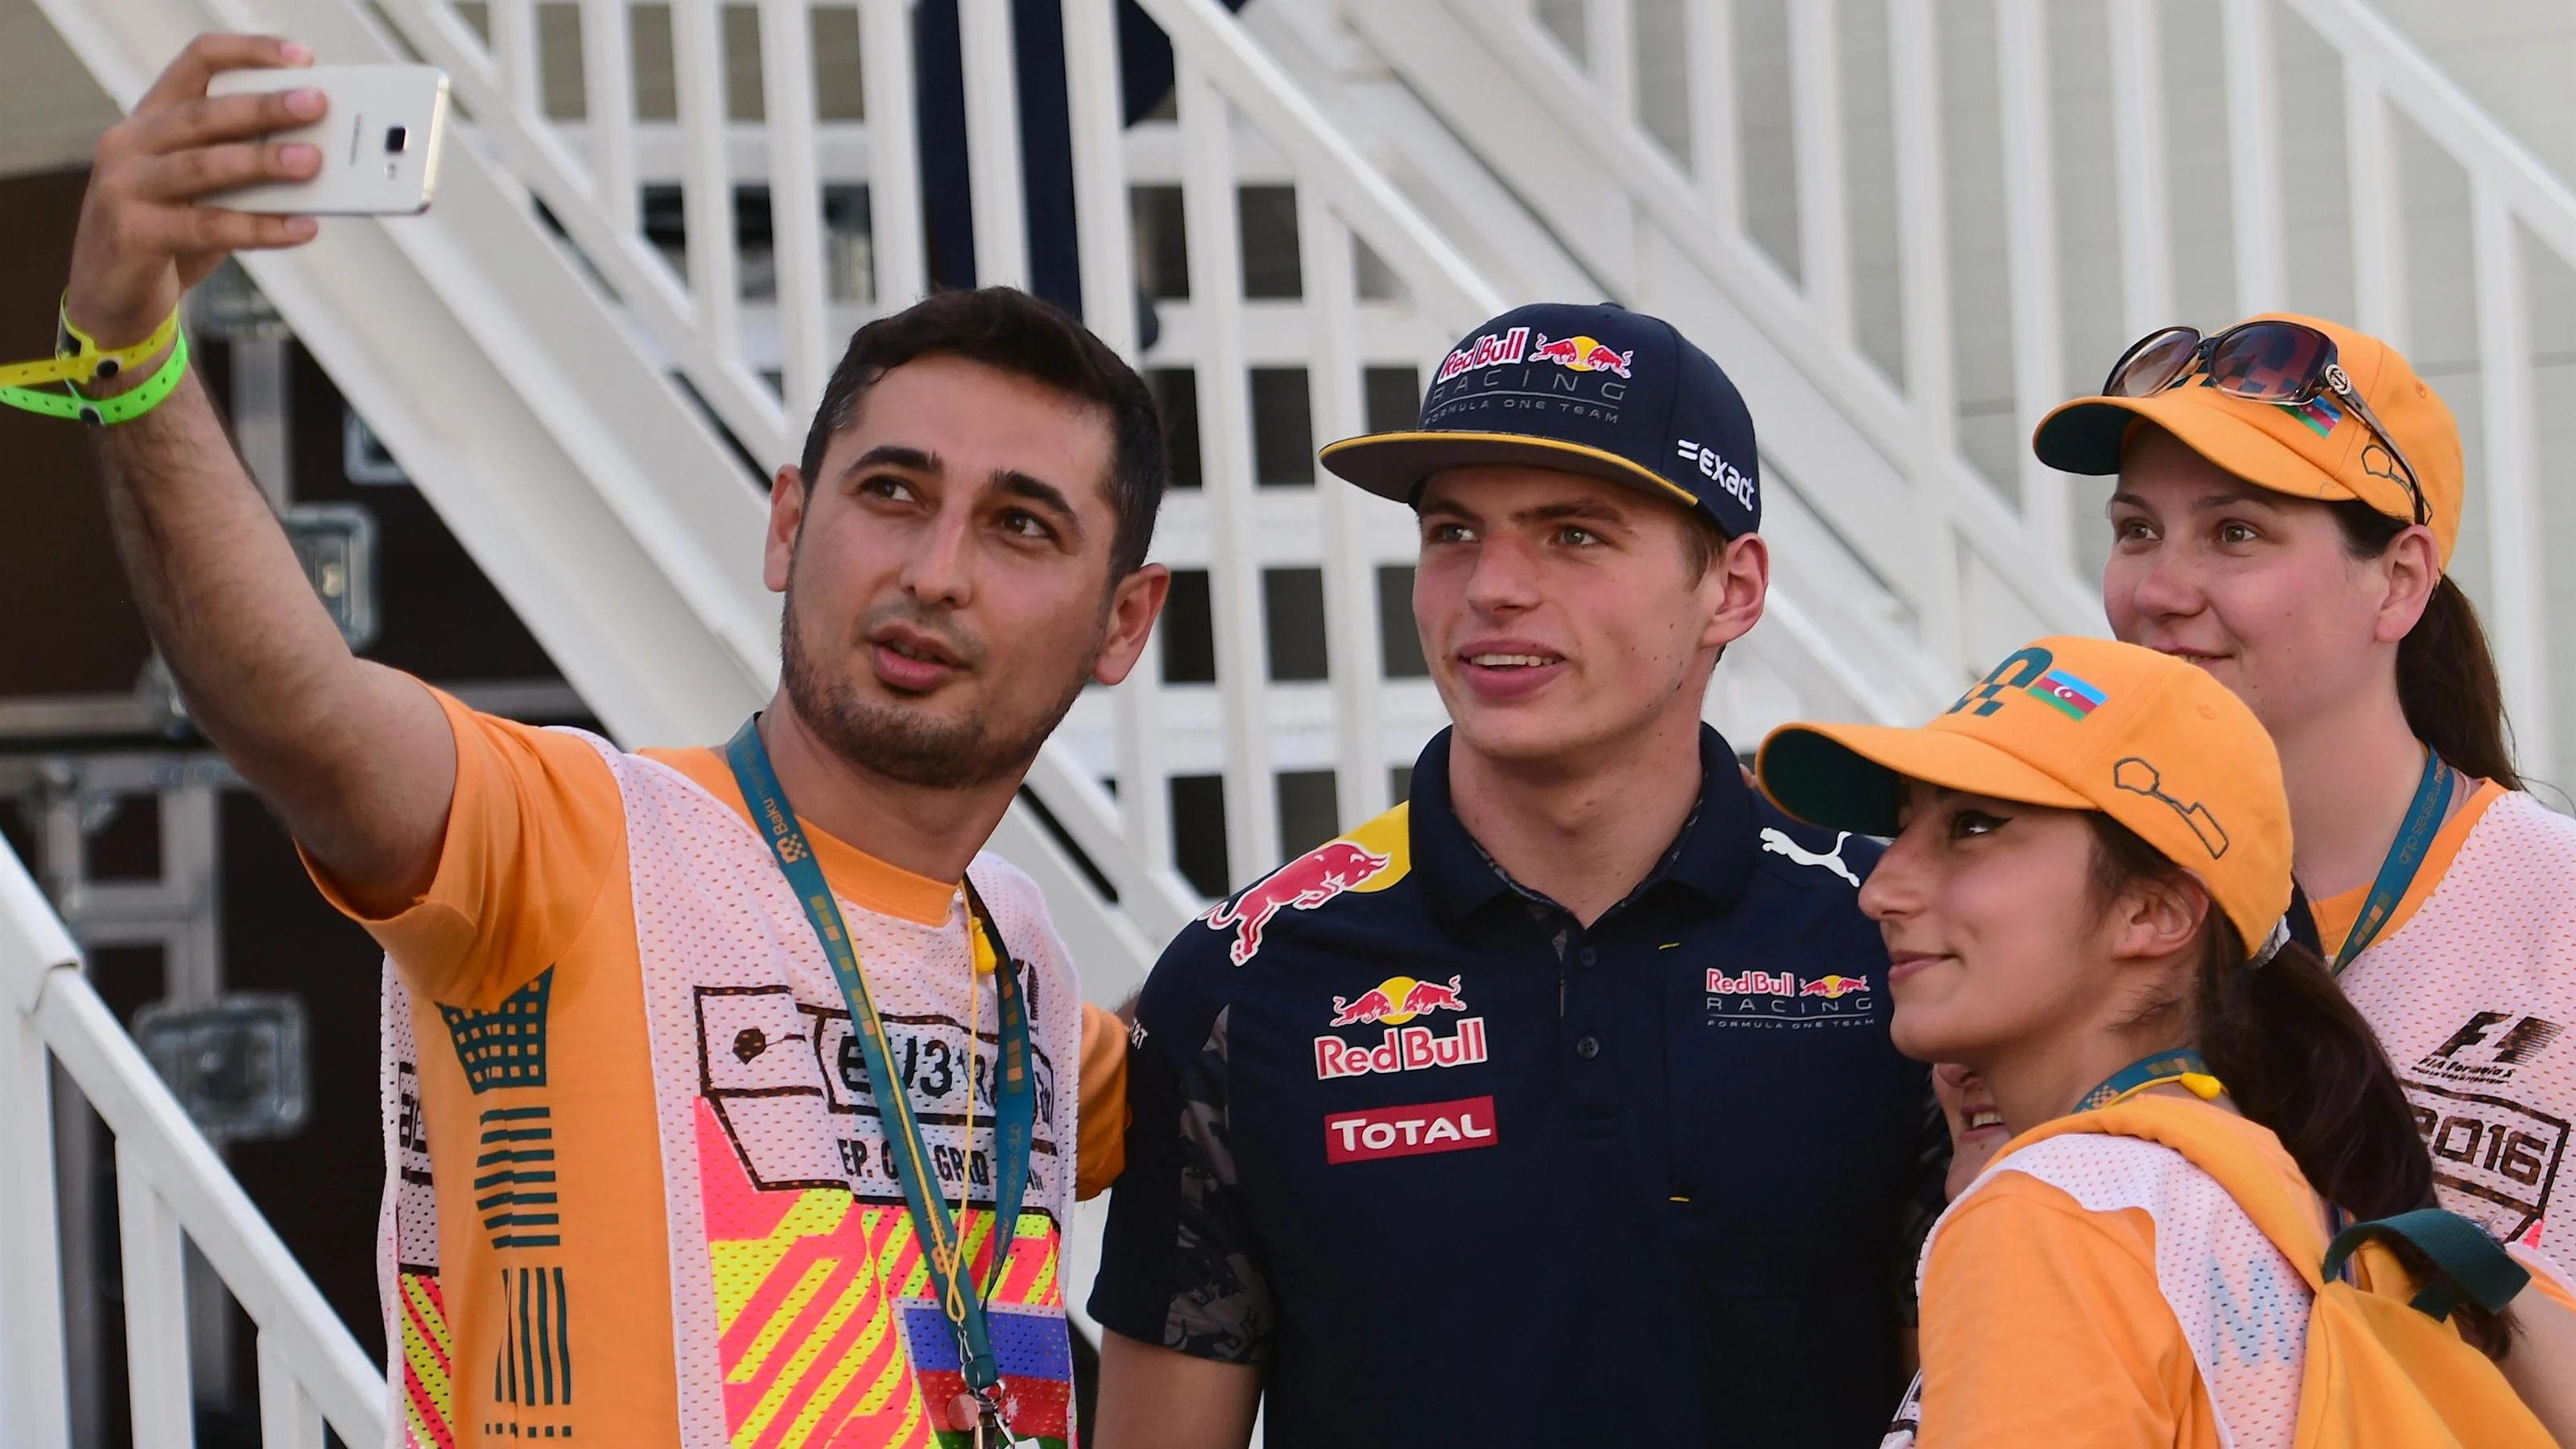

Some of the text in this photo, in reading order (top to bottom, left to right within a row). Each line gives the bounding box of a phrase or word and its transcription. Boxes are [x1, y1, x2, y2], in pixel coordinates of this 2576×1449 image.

[1437, 327, 1530, 384] Red Bull
[1431, 369, 1626, 407] RACING
[1425, 399, 1619, 426] FORMULA ONE TEAM
[764, 797, 790, 836] Baku
[1707, 968, 1794, 997] Red Bull
[1707, 997, 1872, 1014] RACING
[1707, 1018, 1874, 1030] FORMULA ONE TEAM
[1315, 1017, 1488, 1080] Red Bull
[2431, 1011, 2565, 1067] F1
[1331, 1113, 1492, 1152] TOTAL
